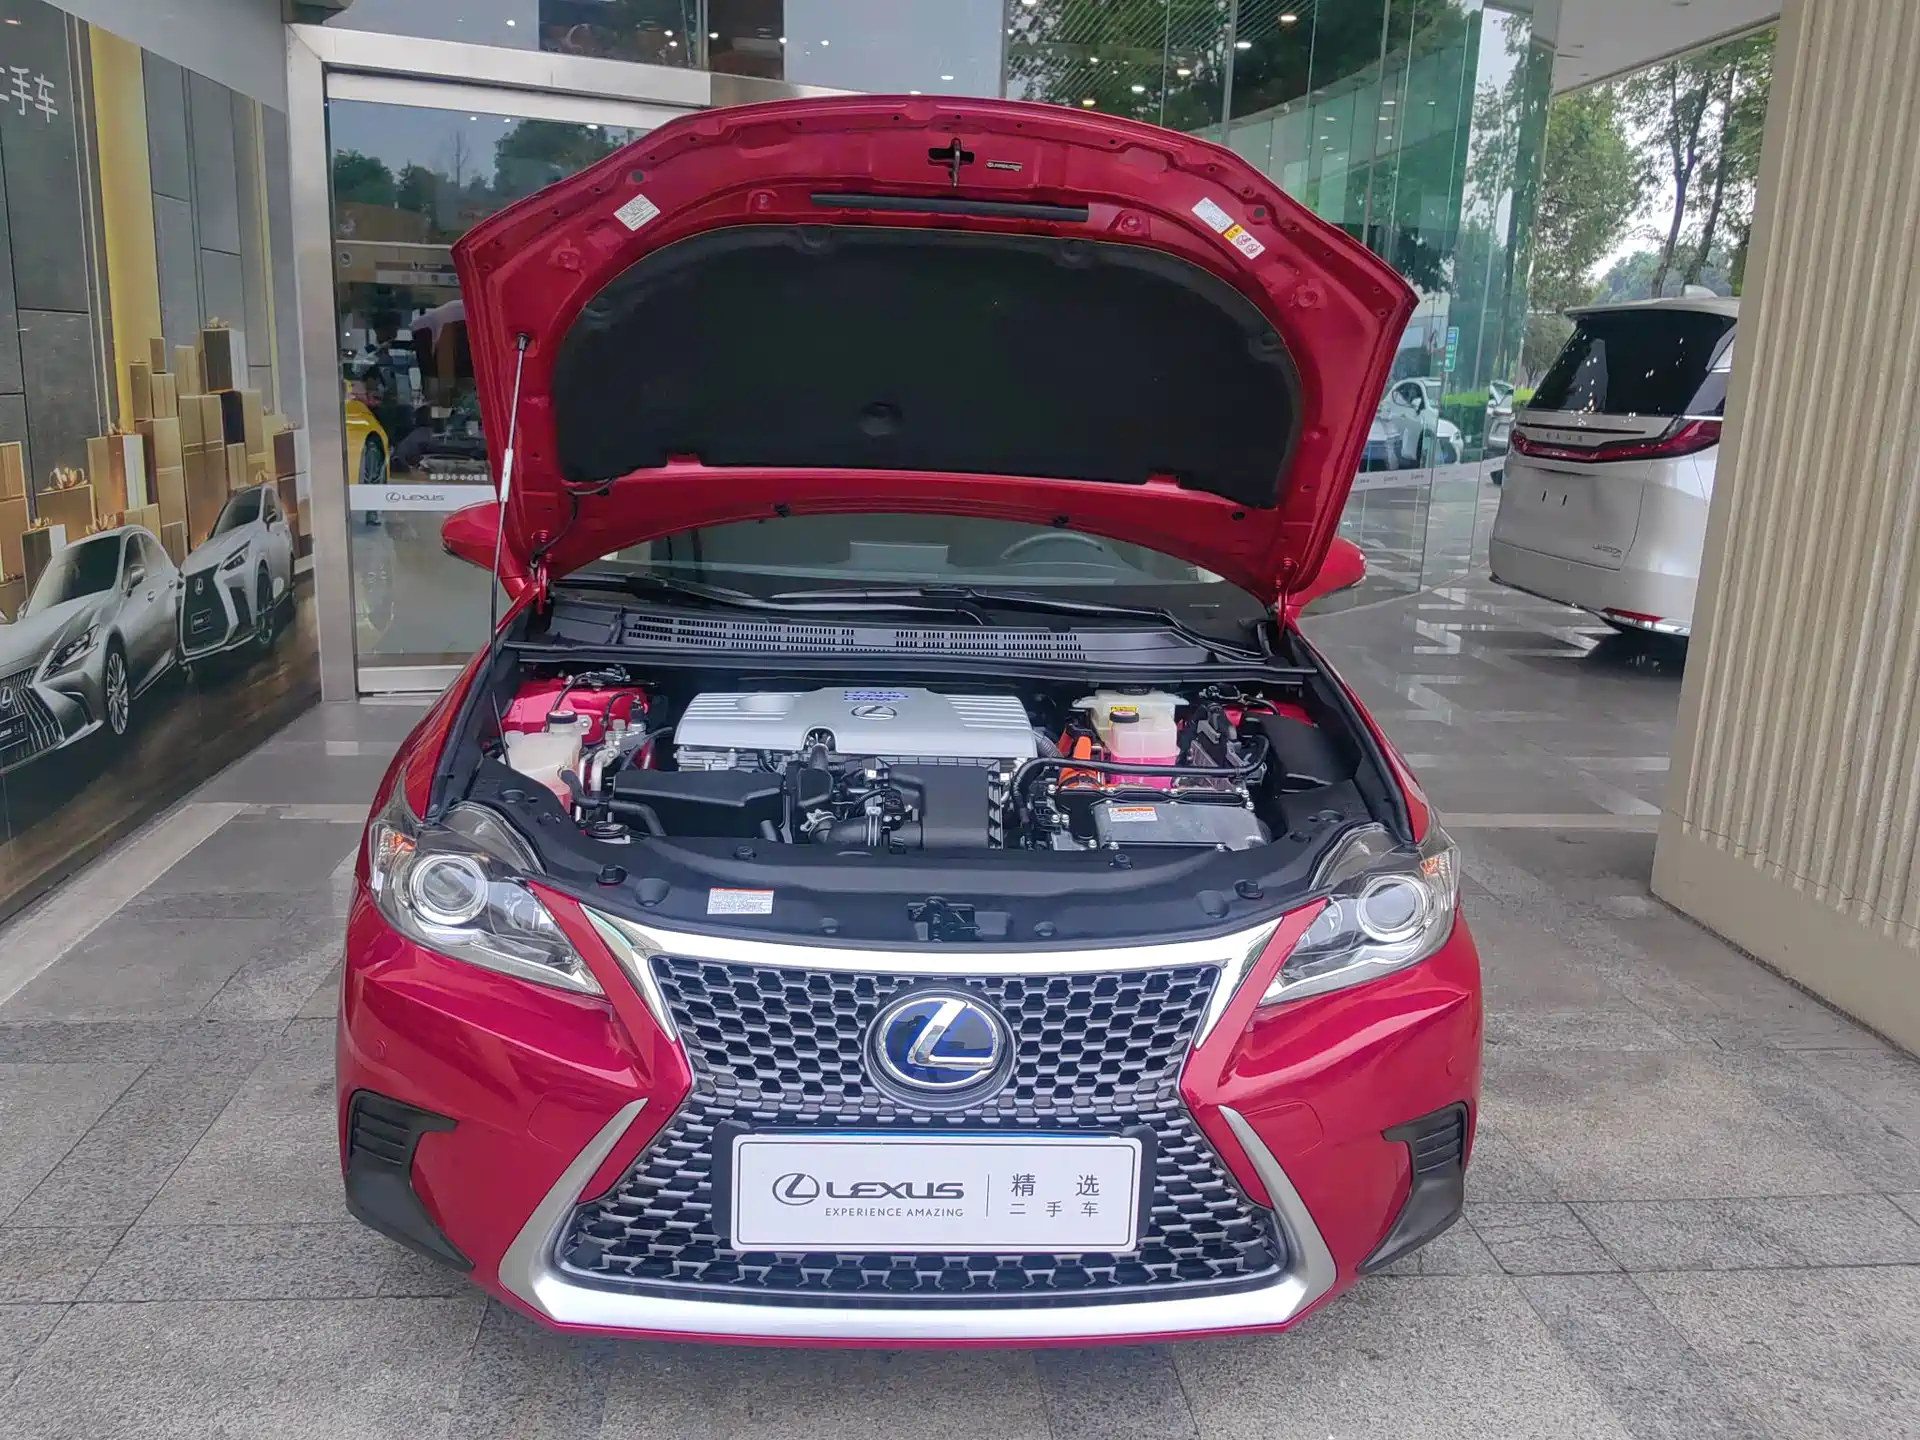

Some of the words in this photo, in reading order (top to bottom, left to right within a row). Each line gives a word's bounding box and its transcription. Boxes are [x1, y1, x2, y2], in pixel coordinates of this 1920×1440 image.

[826, 1181, 965, 1200] LEXUS
[825, 1207, 902, 1217] EXPERIENCE
[906, 1208, 965, 1218] AMAZING
